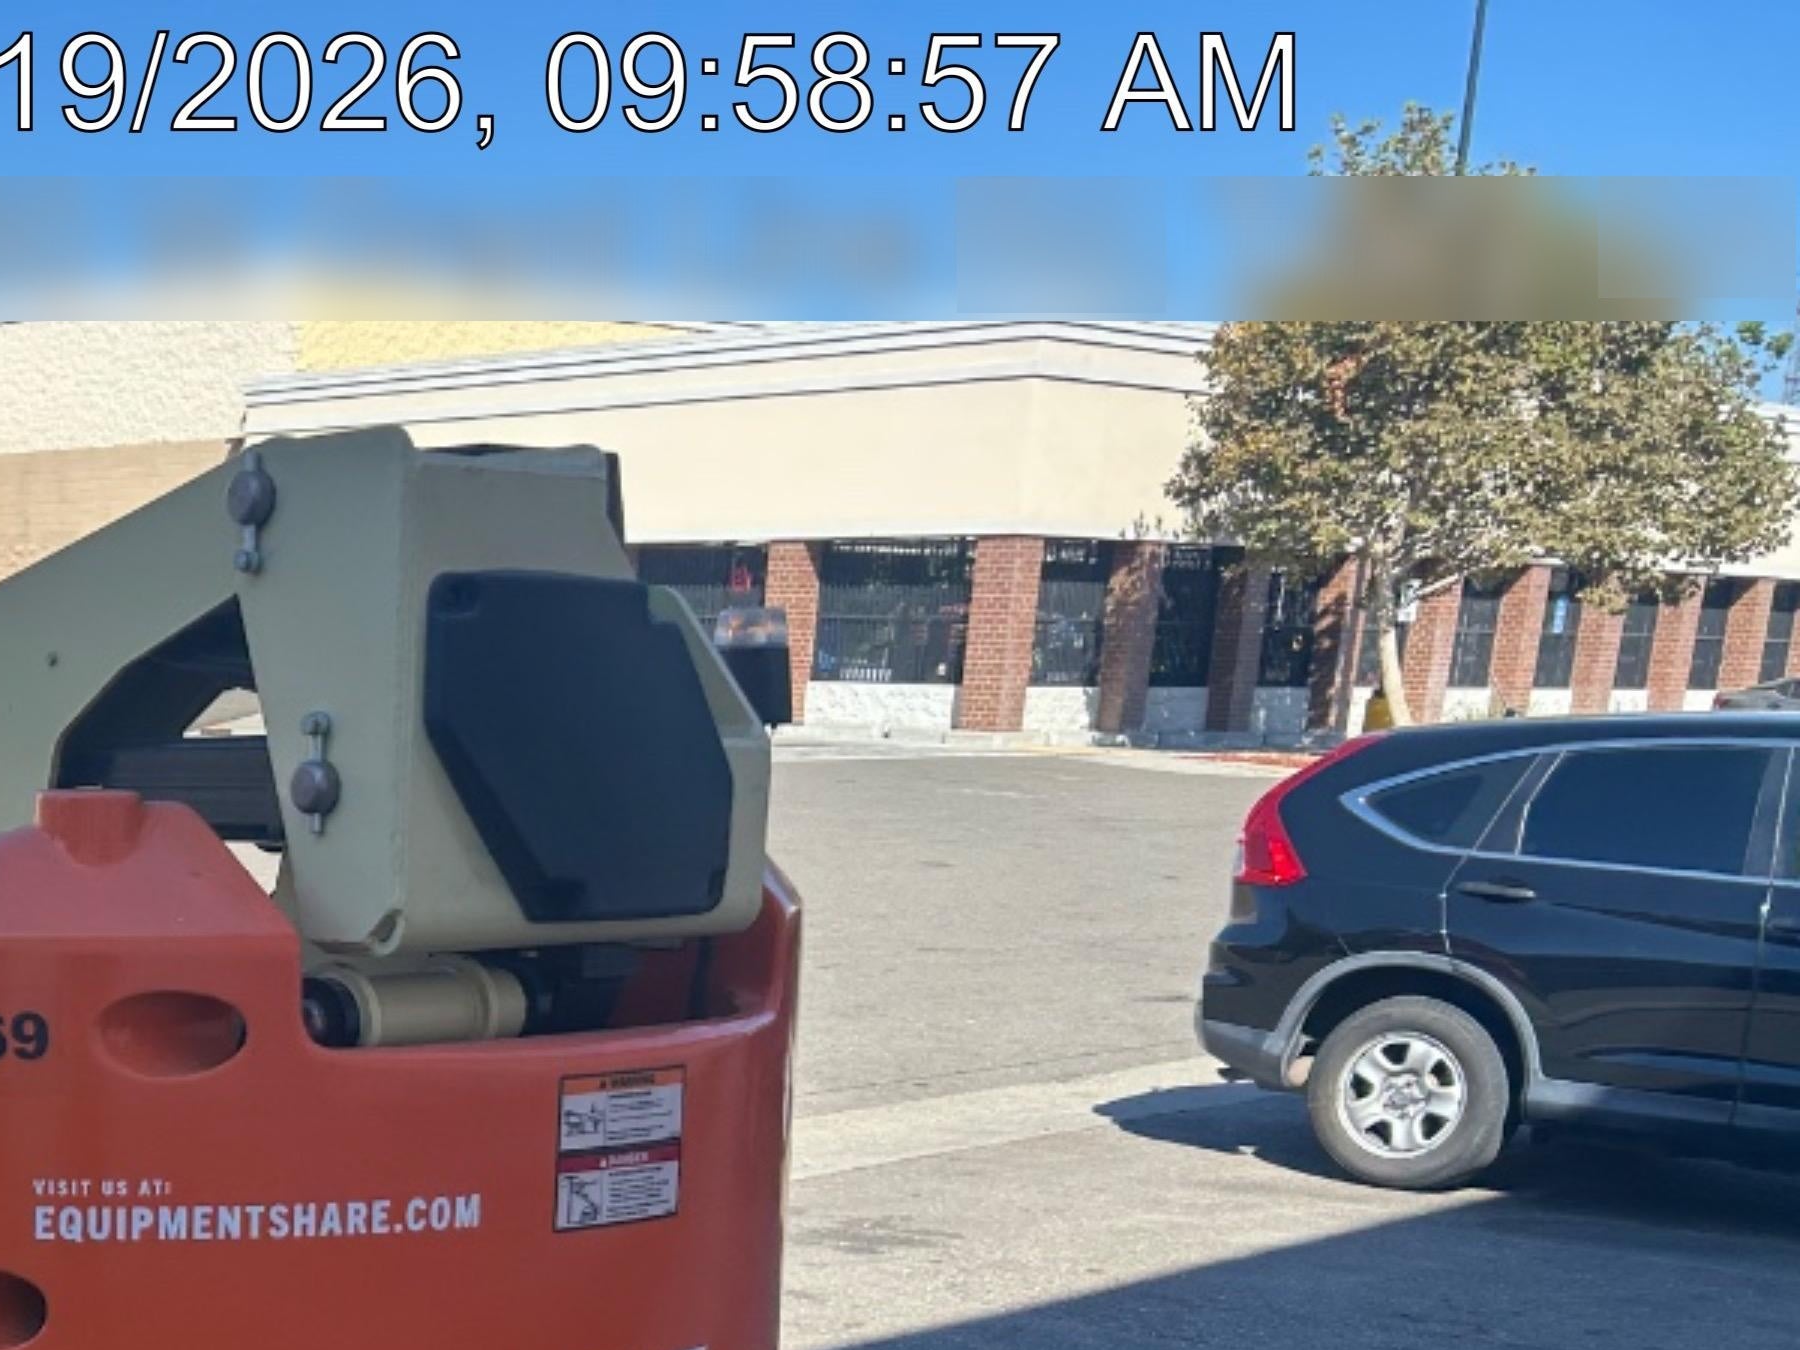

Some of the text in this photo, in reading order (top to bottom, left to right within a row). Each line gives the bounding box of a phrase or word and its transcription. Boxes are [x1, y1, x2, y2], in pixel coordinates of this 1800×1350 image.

[33, 1179, 172, 1196] VISIT US AT:
[33, 1194, 481, 1242] EQUIPMENTSHARE.COM
